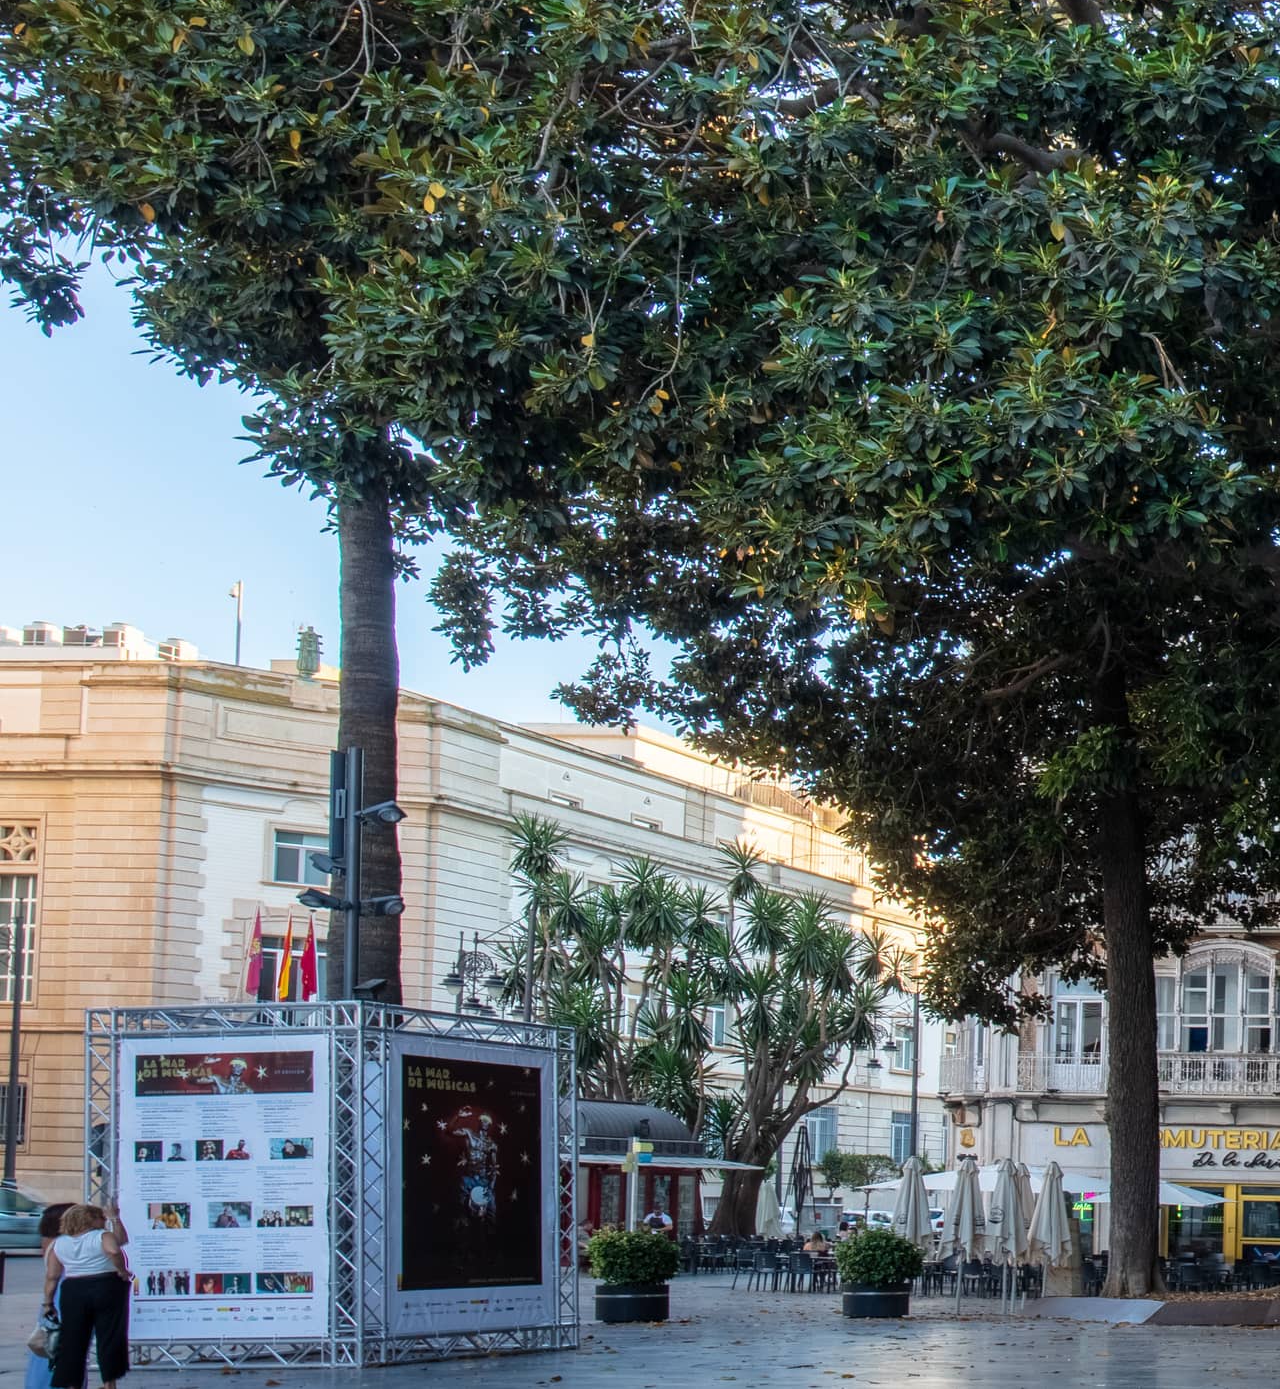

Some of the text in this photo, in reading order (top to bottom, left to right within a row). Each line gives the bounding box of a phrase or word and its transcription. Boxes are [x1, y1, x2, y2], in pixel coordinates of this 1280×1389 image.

[143, 1059, 158, 1069] LA
[407, 1066, 450, 1079] LA MAR
[407, 1077, 423, 1089] DE
[1053, 1127, 1092, 1147] LA
